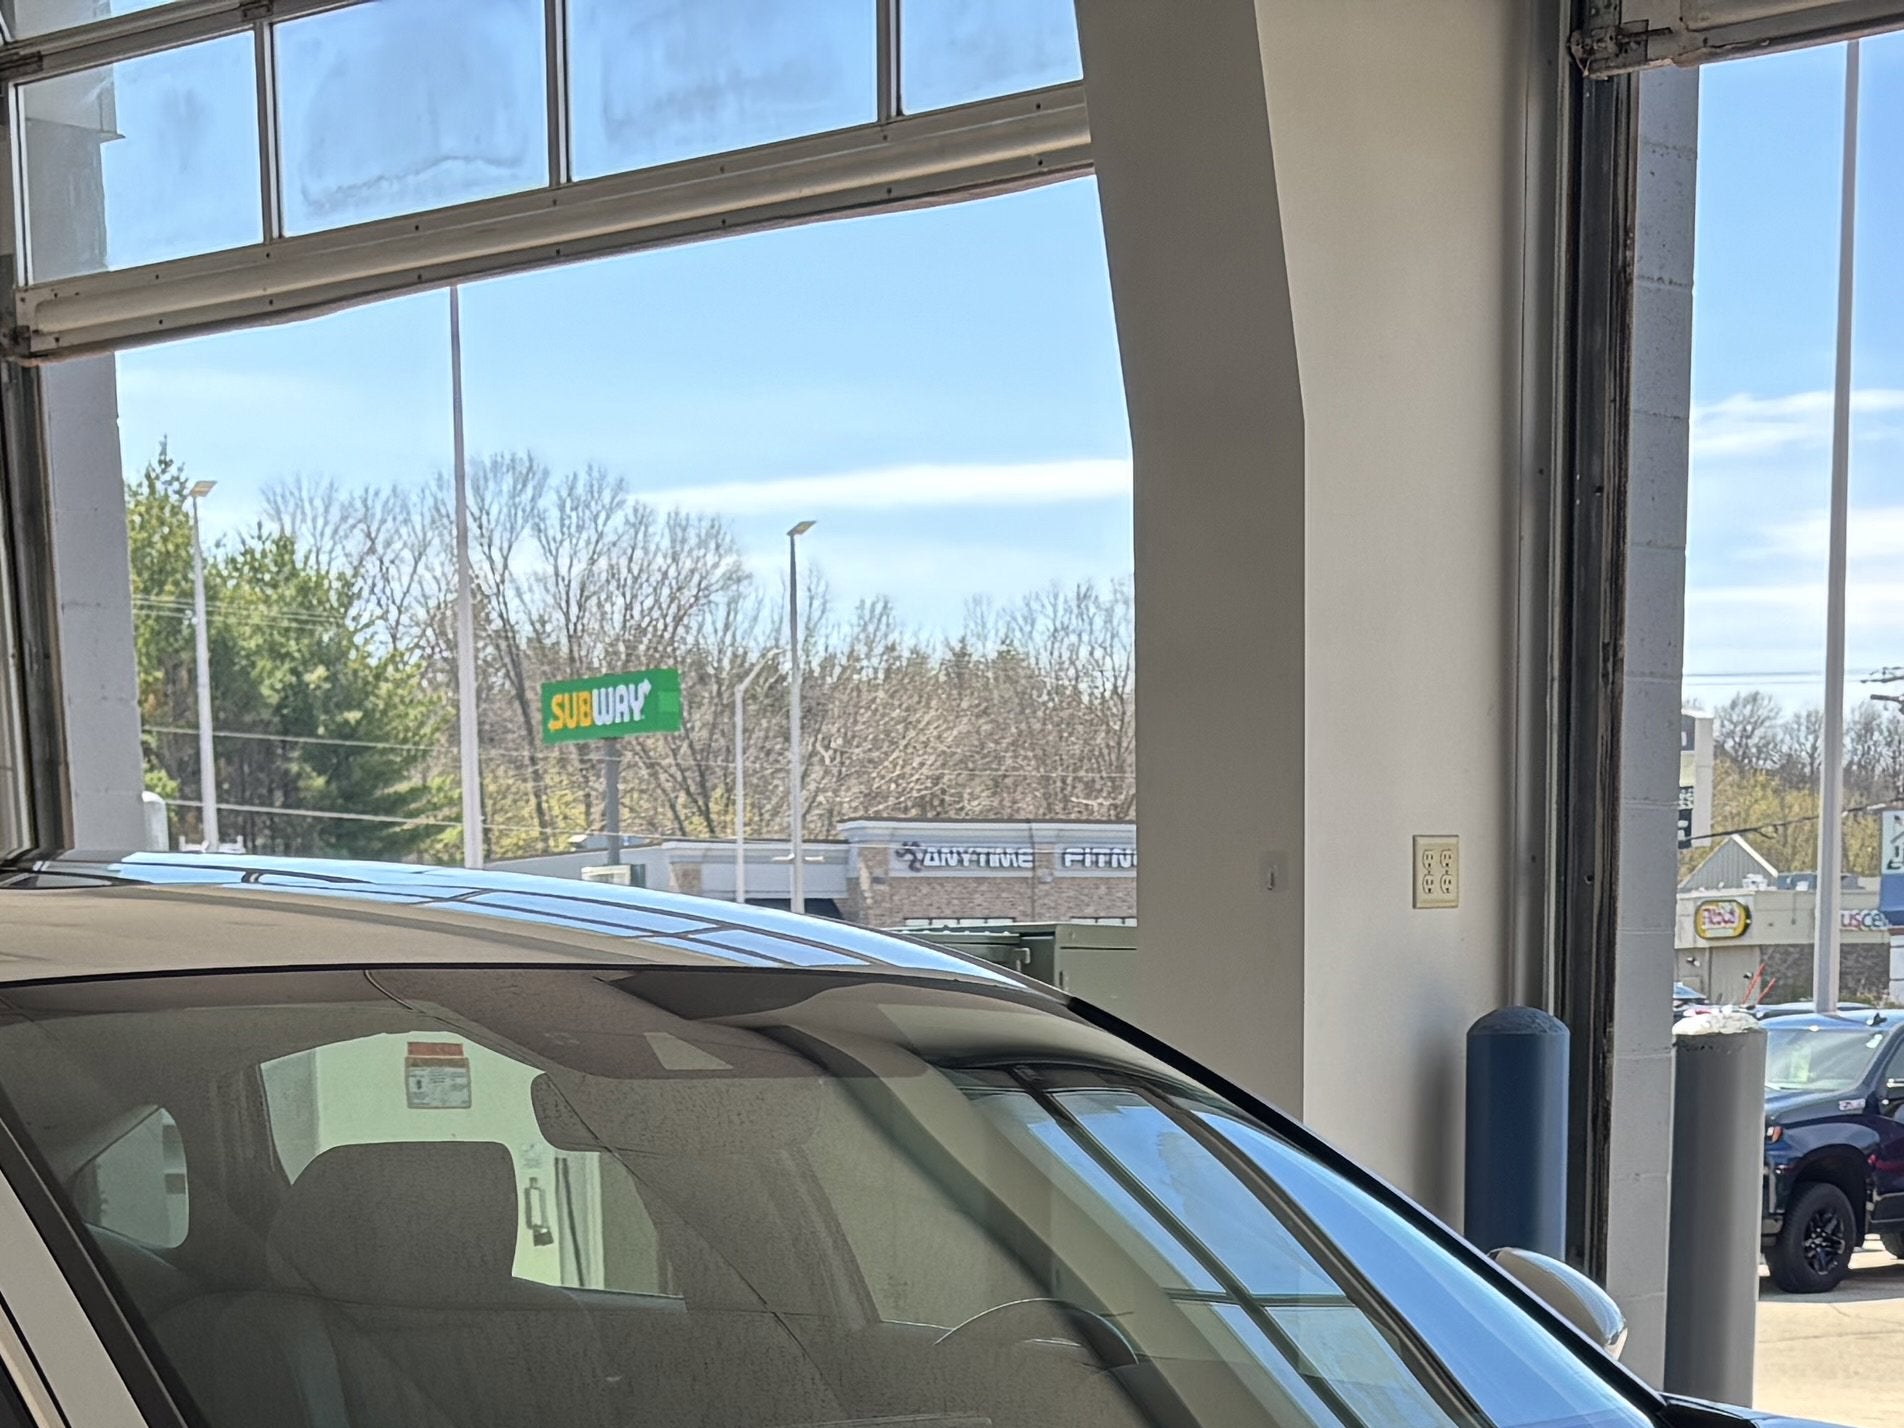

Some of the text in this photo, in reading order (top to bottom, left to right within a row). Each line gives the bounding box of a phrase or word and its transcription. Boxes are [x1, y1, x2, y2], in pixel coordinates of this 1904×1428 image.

[548, 678, 652, 732] SUBWAY
[923, 847, 1137, 868] ANYTIME FITN
